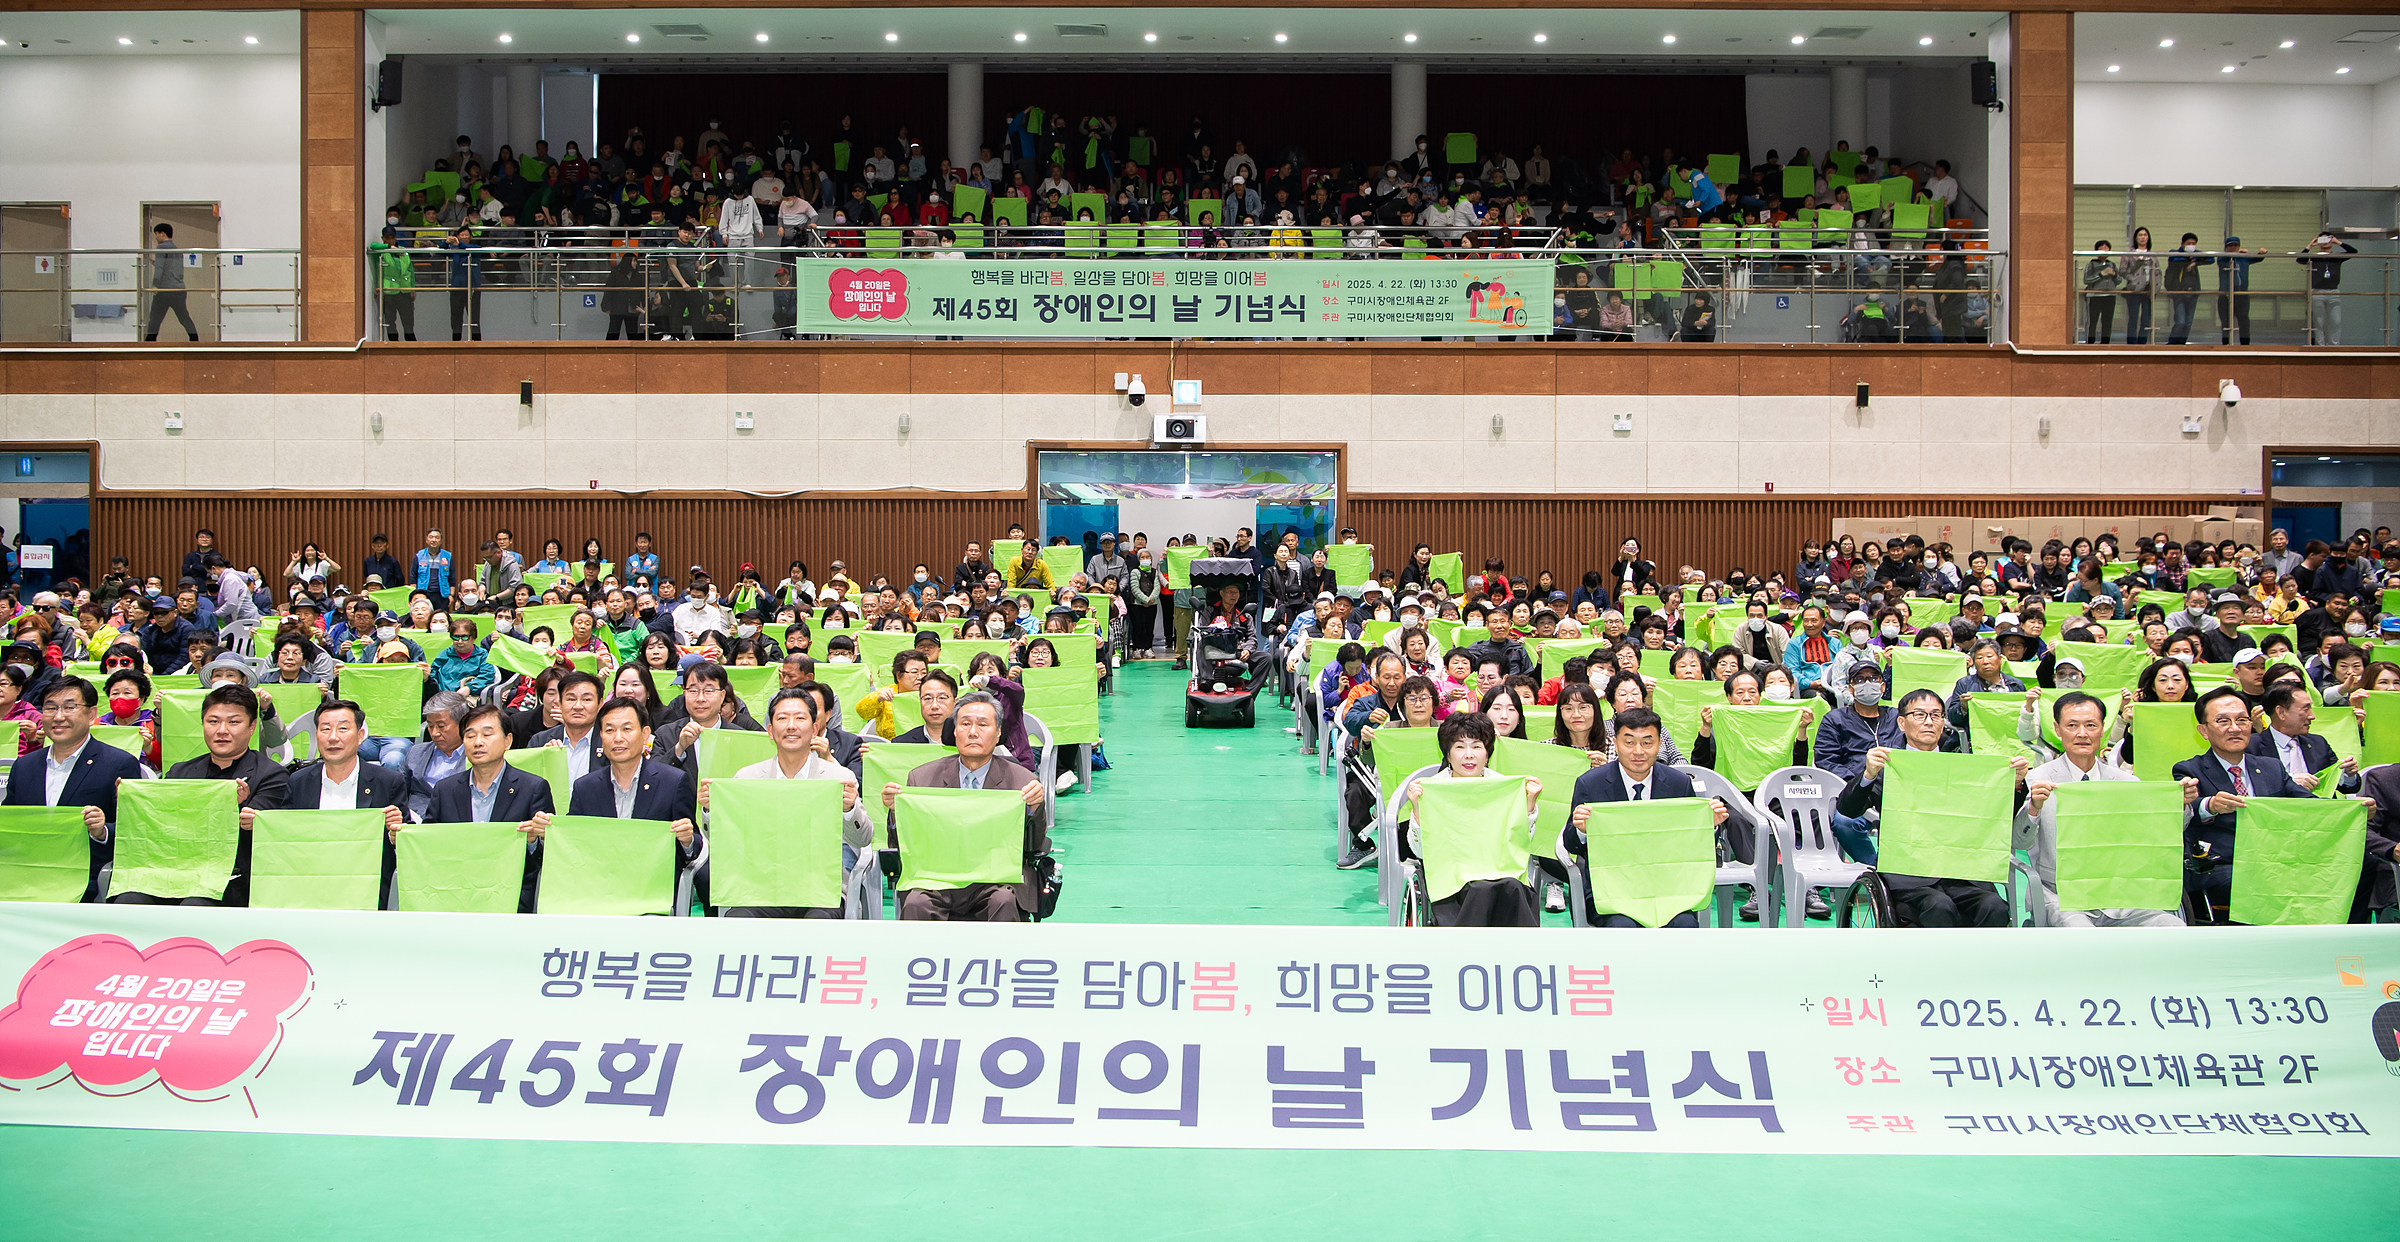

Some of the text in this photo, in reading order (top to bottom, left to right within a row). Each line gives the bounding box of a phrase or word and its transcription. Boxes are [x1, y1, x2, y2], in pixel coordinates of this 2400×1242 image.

[849, 280, 891, 290] 4월 20일은
[971, 269, 1268, 287] 행복을 바라봄, 일상을 담아봄, 희망을 이어봄
[1322, 279, 1340, 289] 일시
[1347, 279, 1458, 290] 2025. 4. 22. (화) 13:30
[844, 290, 897, 303] 장애인의 날
[1322, 296, 1340, 306] 장소
[1347, 295, 1450, 306] 구미시장애인체육관 2F
[858, 303, 882, 312] 입니다
[932, 294, 1306, 324] 제45회 장애인의 날 기념식
[1322, 312, 1340, 322] 주관
[1347, 312, 1454, 323] 구미시장애인단체협의회
[94, 974, 246, 1004] 4월 20일은
[541, 948, 1614, 1016] 행복을 바라봄, 일상을 담아봄, 희망을 이어봄
[49, 998, 249, 1036] 장애인의 날
[1823, 997, 1887, 1026] 일시
[1917, 996, 2328, 1030] 2025. 4. 22. (화) 13:30
[82, 1031, 173, 1060] 입니다
[1834, 1057, 1900, 1086] 장소
[1930, 1053, 2319, 1089] 구미시장애인체육관 2F
[352, 1031, 1784, 1132] 제45회 장애인의 날 기념식
[1846, 1115, 1917, 1133] 주관
[1944, 1112, 2371, 1135] 구미시장애인단체협의회
